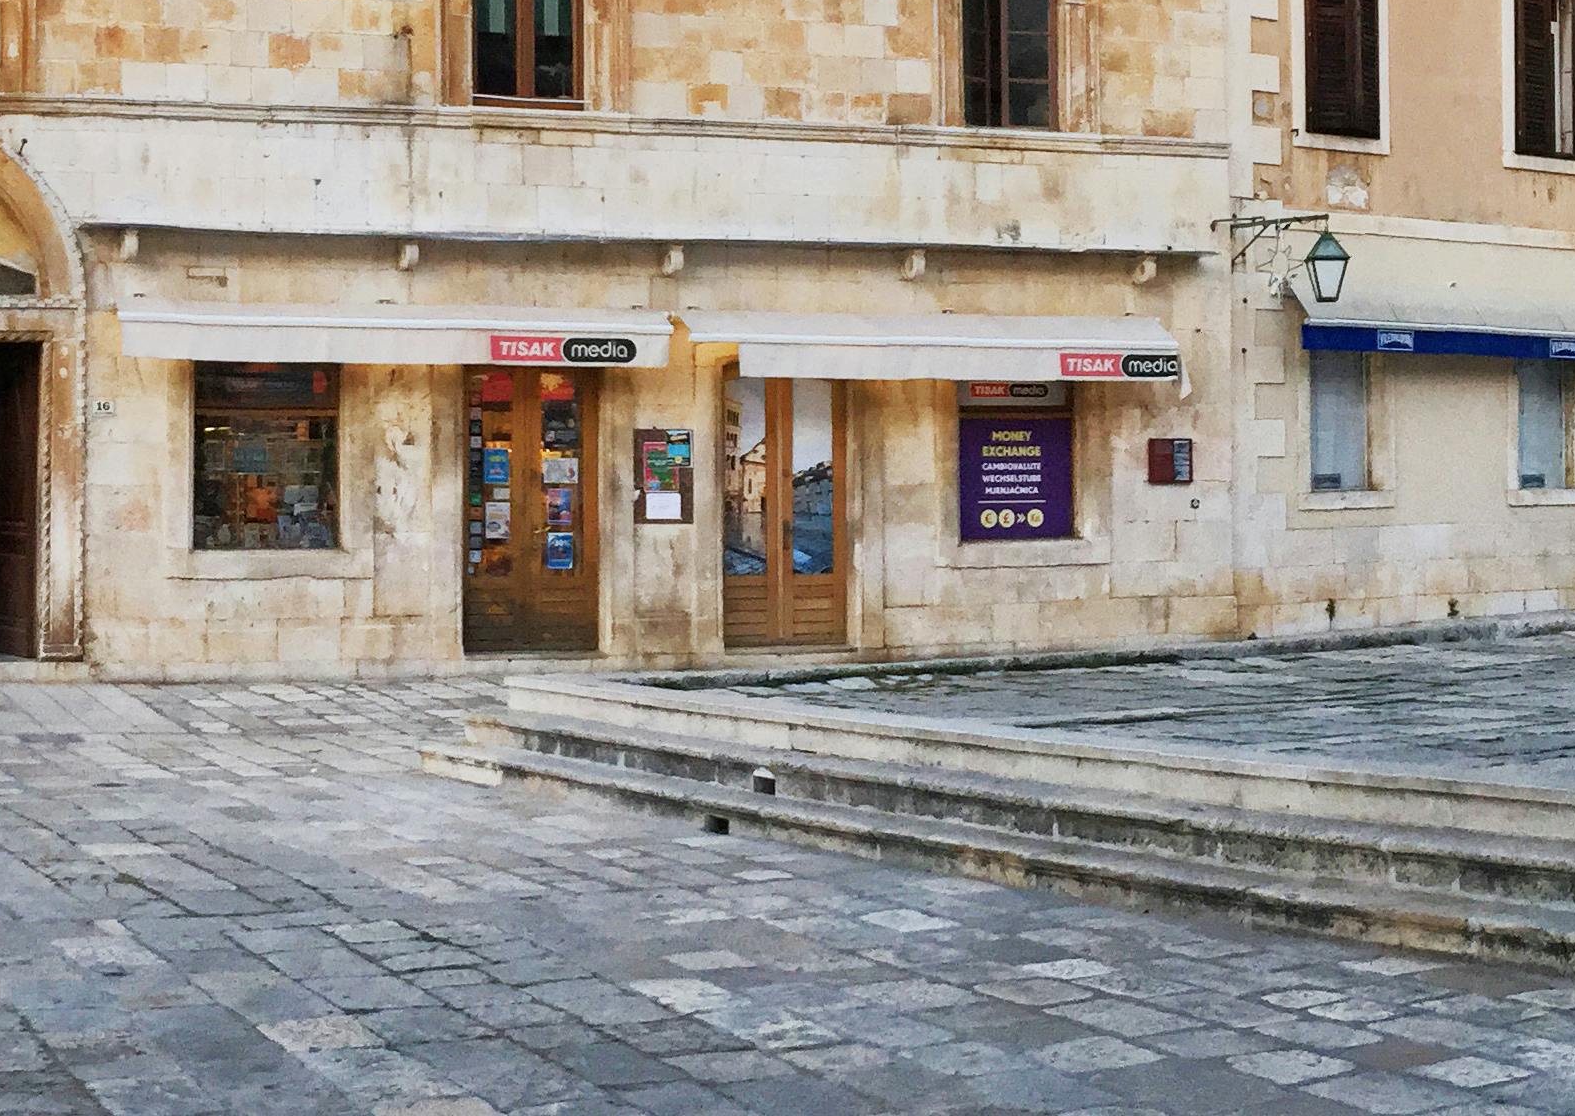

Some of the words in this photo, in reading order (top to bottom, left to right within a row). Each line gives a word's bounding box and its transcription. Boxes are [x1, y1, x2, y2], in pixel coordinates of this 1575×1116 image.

[499, 340, 556, 357] TISAK
[571, 341, 628, 358] media
[1066, 357, 1116, 372] TISAK
[1128, 357, 1177, 373] media
[973, 385, 1005, 395] TISAK
[1012, 385, 1045, 395] media
[96, 401, 111, 411] 16
[991, 431, 1033, 441] MONEY
[982, 446, 1042, 457] EXCHANGE
[982, 474, 1042, 482] WECHSELSTUBE
